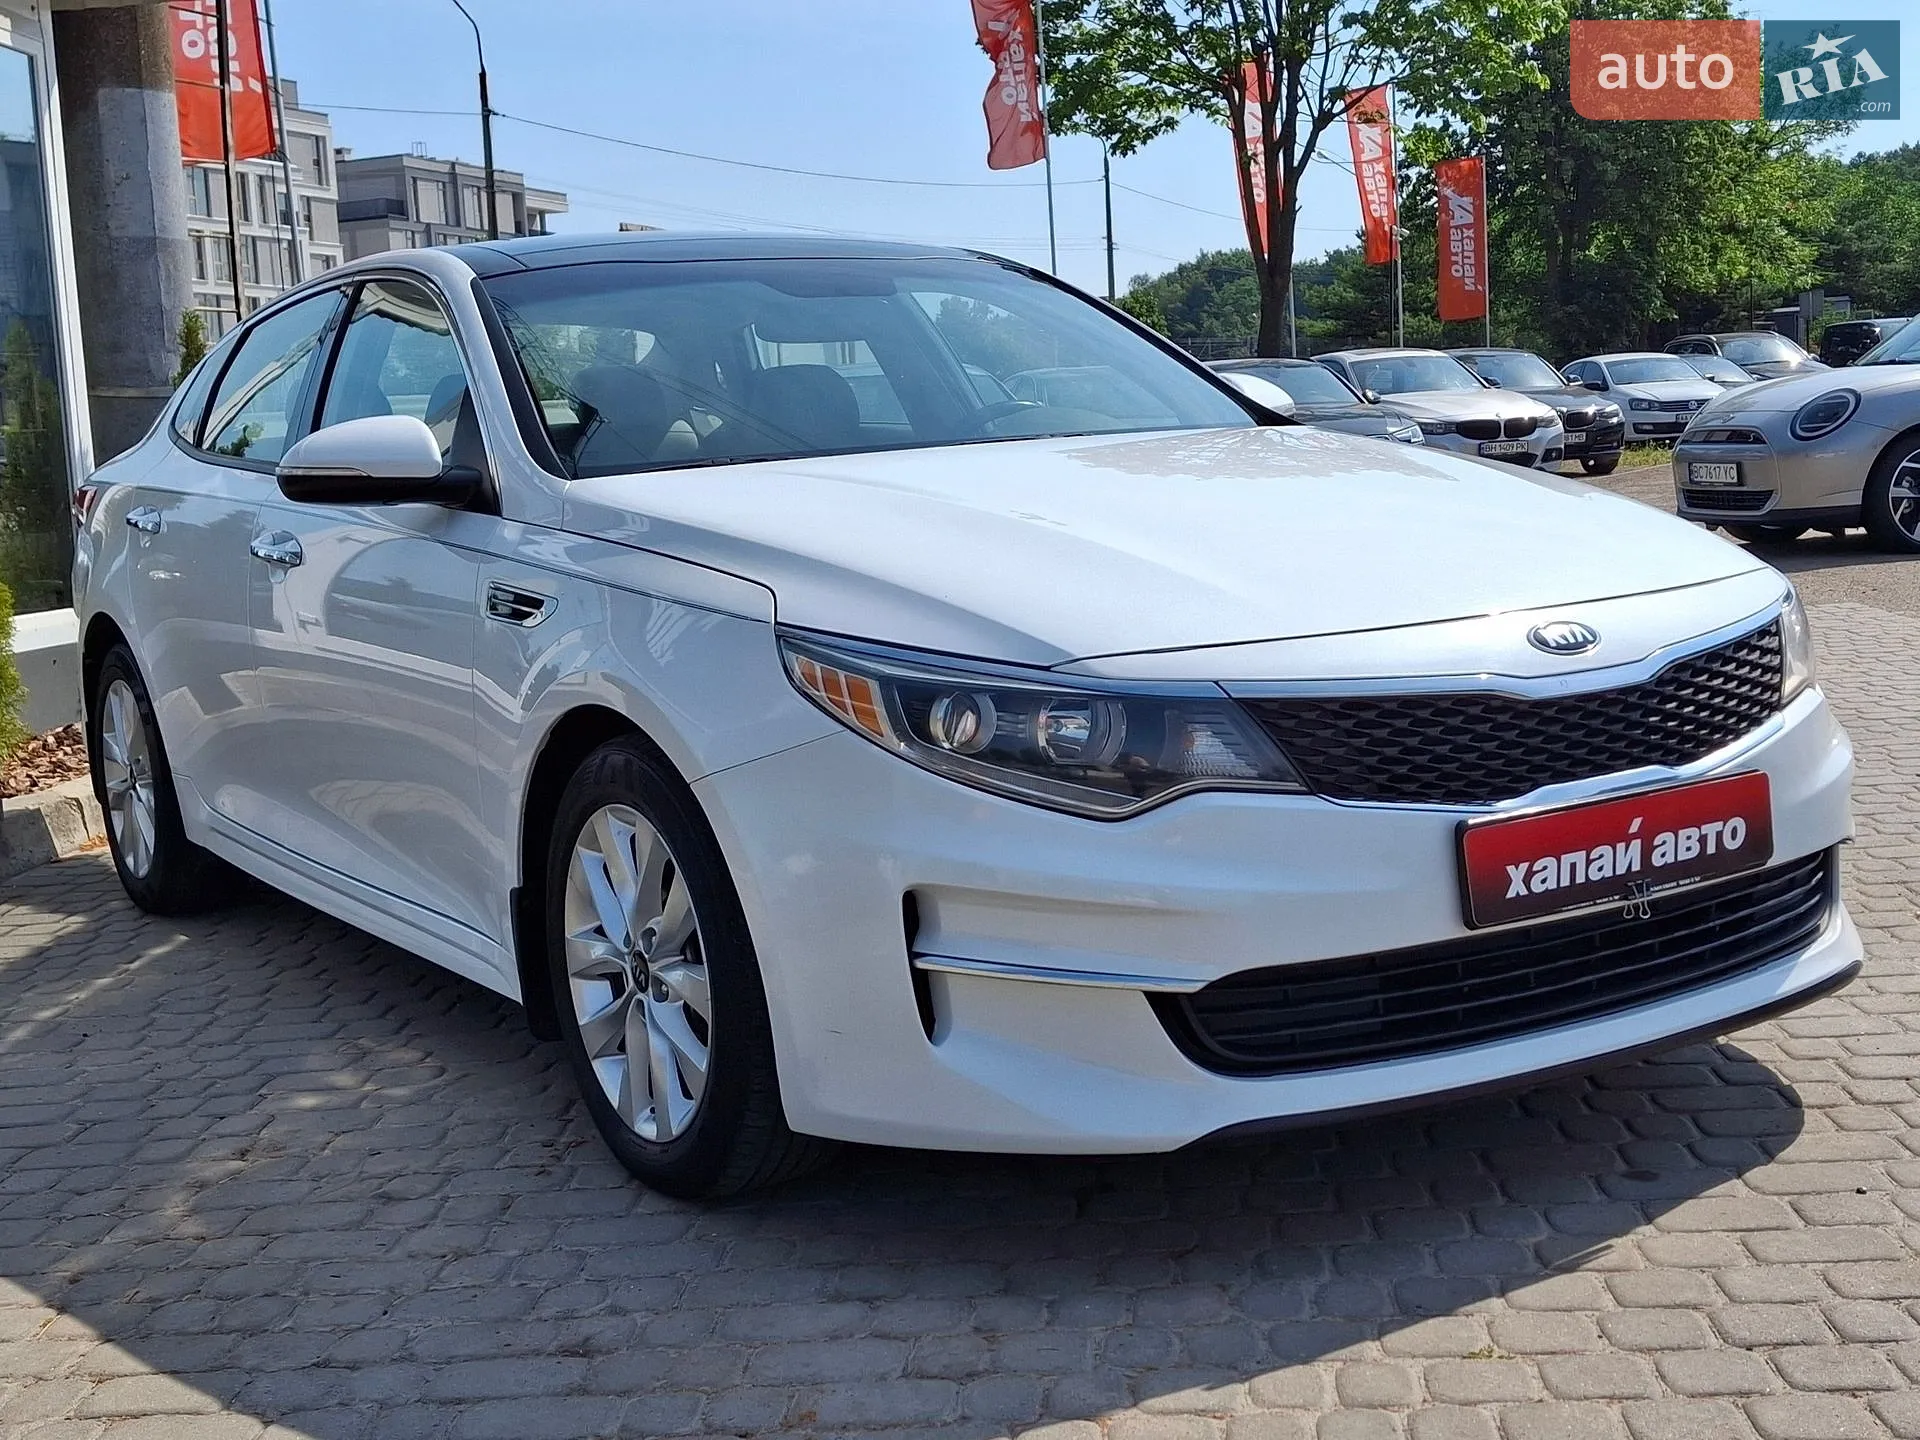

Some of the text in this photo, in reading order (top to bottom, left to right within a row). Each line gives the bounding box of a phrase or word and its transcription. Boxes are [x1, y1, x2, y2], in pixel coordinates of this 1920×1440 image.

[1362, 164, 1380, 218] авто
[1373, 162, 1389, 231] хапа
[1450, 228, 1463, 277] авто
[1463, 228, 1483, 291] хапай
[1504, 816, 1746, 899] хапай авто
